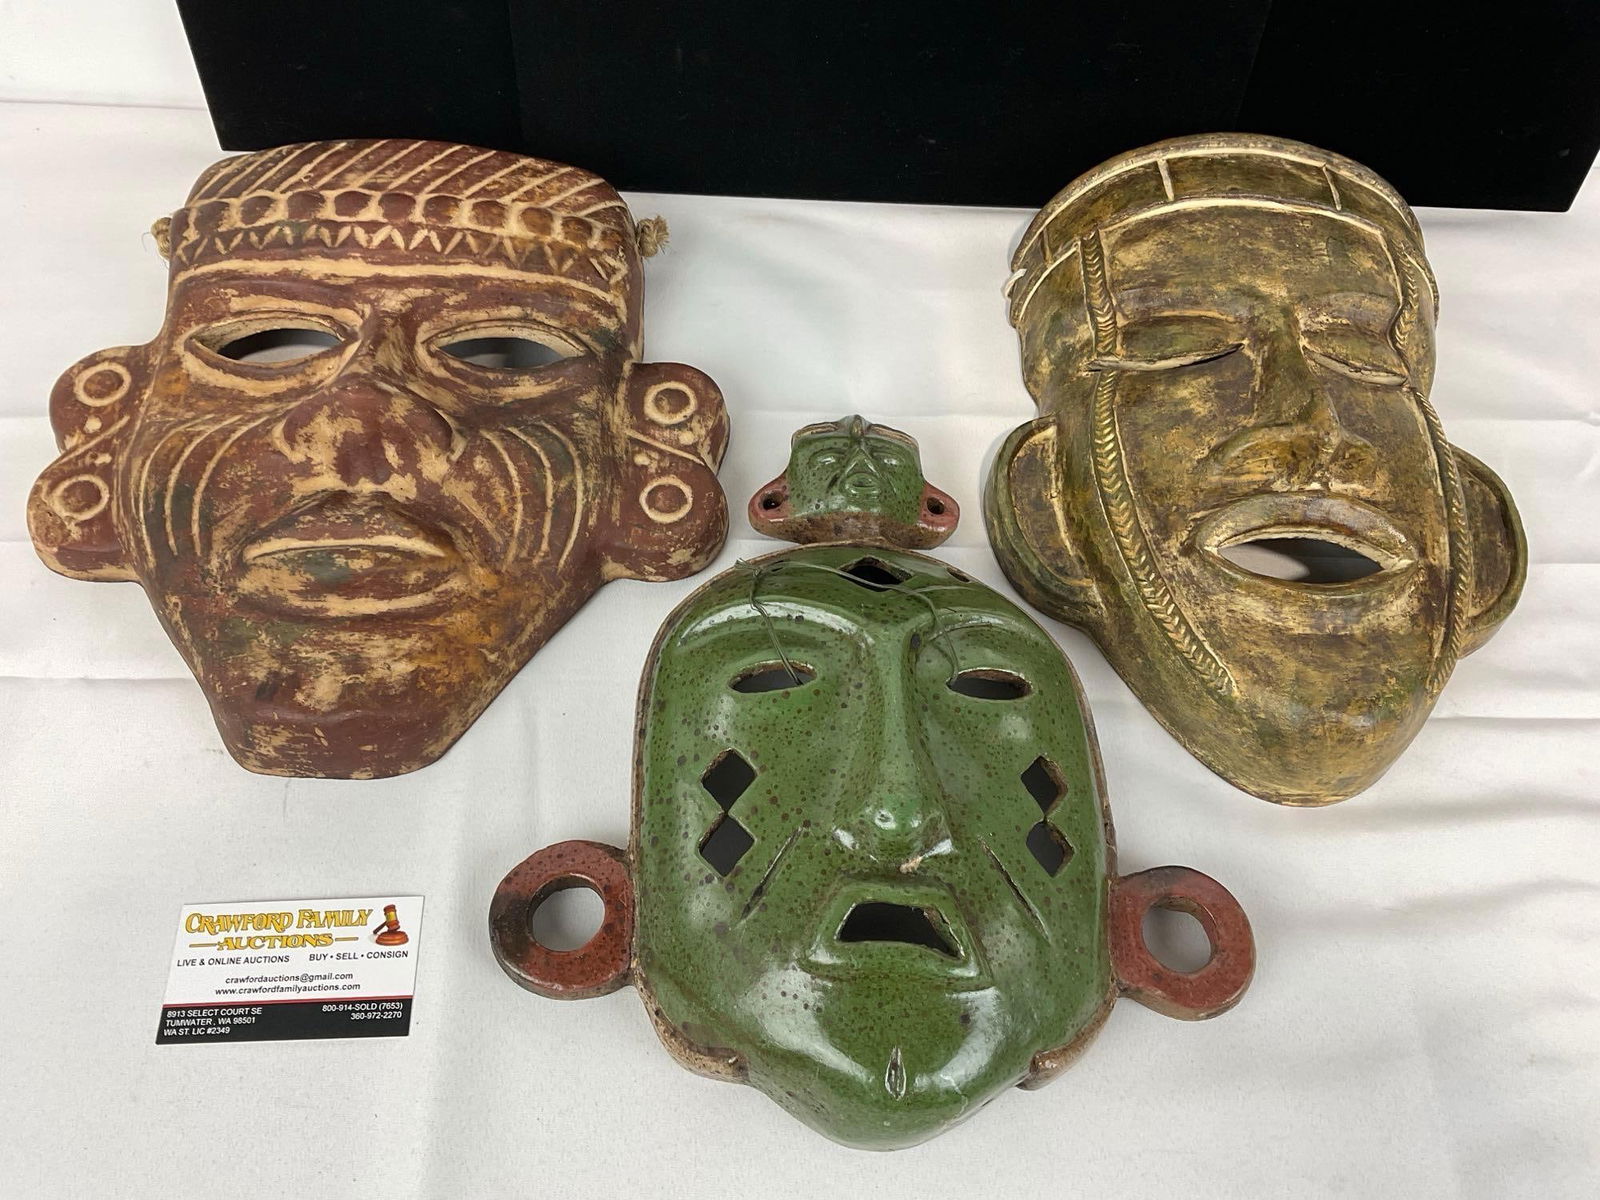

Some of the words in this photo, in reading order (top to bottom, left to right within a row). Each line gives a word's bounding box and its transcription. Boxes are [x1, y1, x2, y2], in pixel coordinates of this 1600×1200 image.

[185, 910, 293, 936] CRAWFORD
[296, 908, 373, 929] FAMILY
[217, 933, 333, 950] AUCTIONS
[177, 959, 197, 967] LIVE
[199, 958, 205, 966] &
[208, 957, 242, 965] ONLINE
[243, 955, 290, 964] AUCTIONS
[309, 953, 327, 961] BUY
[336, 952, 358, 960] SELL
[366, 950, 408, 959] CONSIGN
[225, 972, 353, 984] crawfordauctions@gmail.com
[215, 983, 360, 996] www.crawfordfamilyauctions.com
[167, 1010, 186, 1018] 8913
[187, 1009, 220, 1017] SELECT
[220, 1008, 250, 1016] COURT
[250, 1007, 262, 1015] SE
[322, 1003, 377, 1012] 800-914-SOLD
[378, 1002, 403, 1011] (7653)
[233, 1016, 256, 1024] 98501
[351, 1011, 402, 1020] 360-972-2270
[164, 1028, 178, 1036] WA
[207, 1026, 230, 1035] #2349
